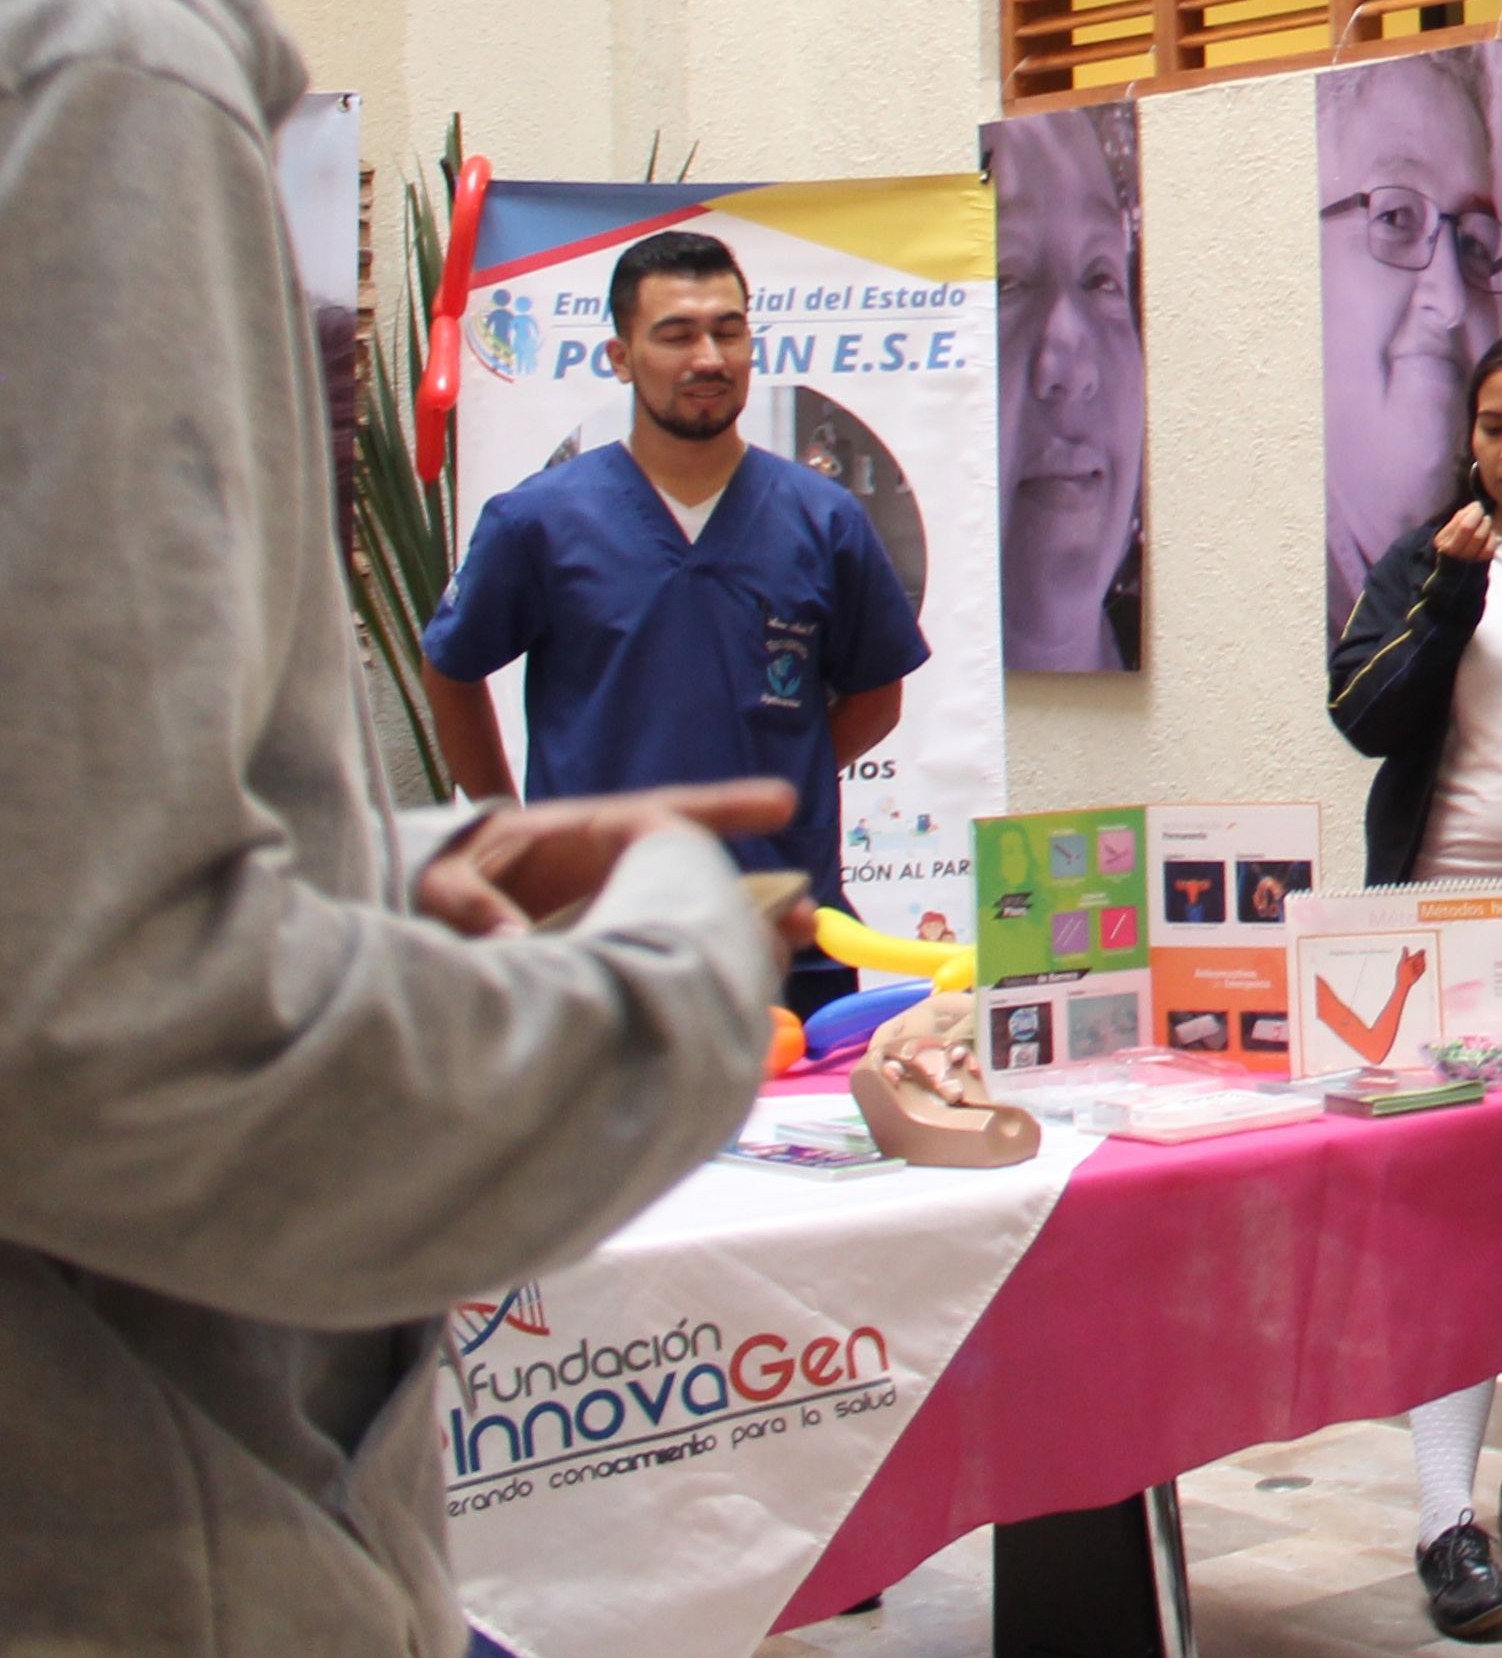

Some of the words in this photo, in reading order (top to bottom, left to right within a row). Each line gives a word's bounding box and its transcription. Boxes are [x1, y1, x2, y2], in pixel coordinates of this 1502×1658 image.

[804, 284, 853, 311] del
[859, 281, 967, 311] Estado
[831, 329, 967, 374] E.S.E.
[840, 860, 893, 884] CIÓN
[898, 862, 924, 880] AL
[931, 859, 972, 879] PAR
[1421, 902, 1485, 919] Métodos
[467, 1317, 723, 1403] Fundación
[450, 1325, 890, 1477] InnovaGen
[448, 1478, 534, 1518] erando
[731, 1415, 787, 1451] para
[801, 1406, 821, 1427] la
[834, 1384, 897, 1418] salud
